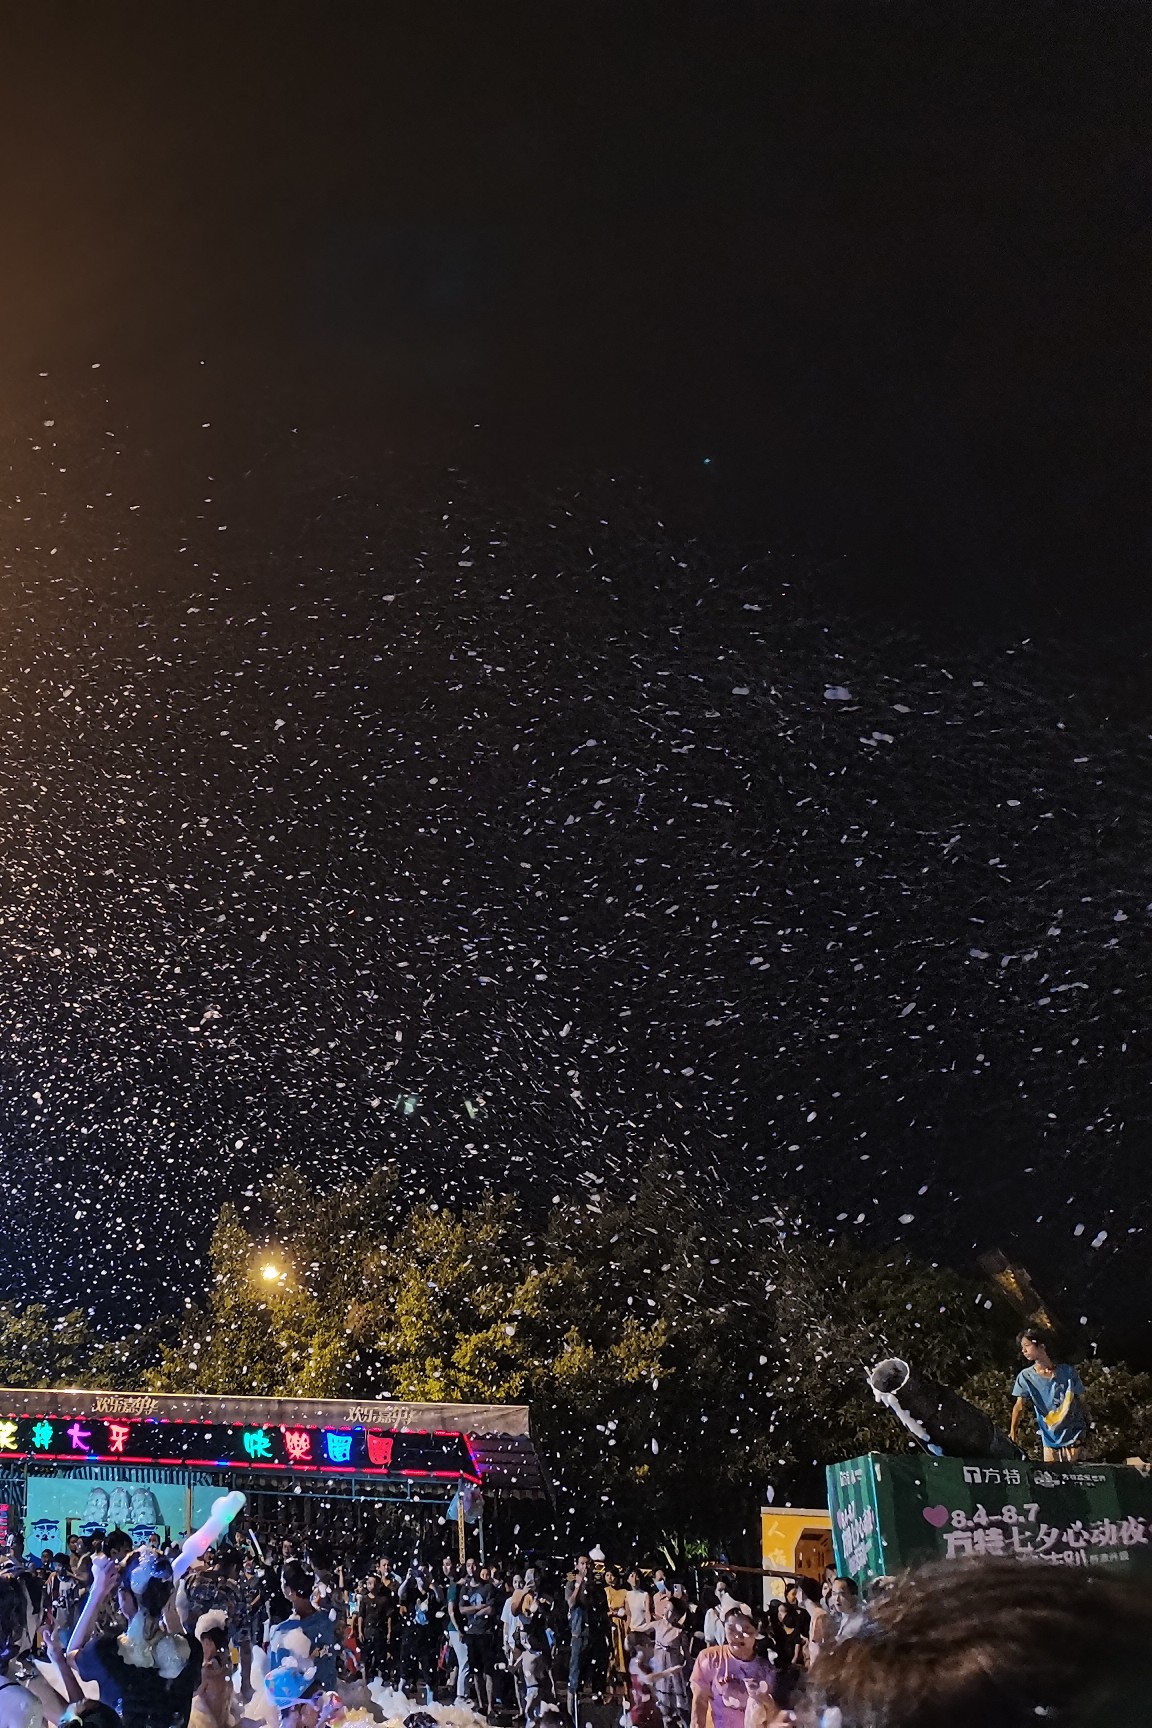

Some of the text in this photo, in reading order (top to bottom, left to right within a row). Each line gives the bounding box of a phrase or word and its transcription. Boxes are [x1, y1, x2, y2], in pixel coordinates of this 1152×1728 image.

[92, 1396, 159, 1415] 欢乐嘉年华
[982, 1468, 1021, 1485] 方特
